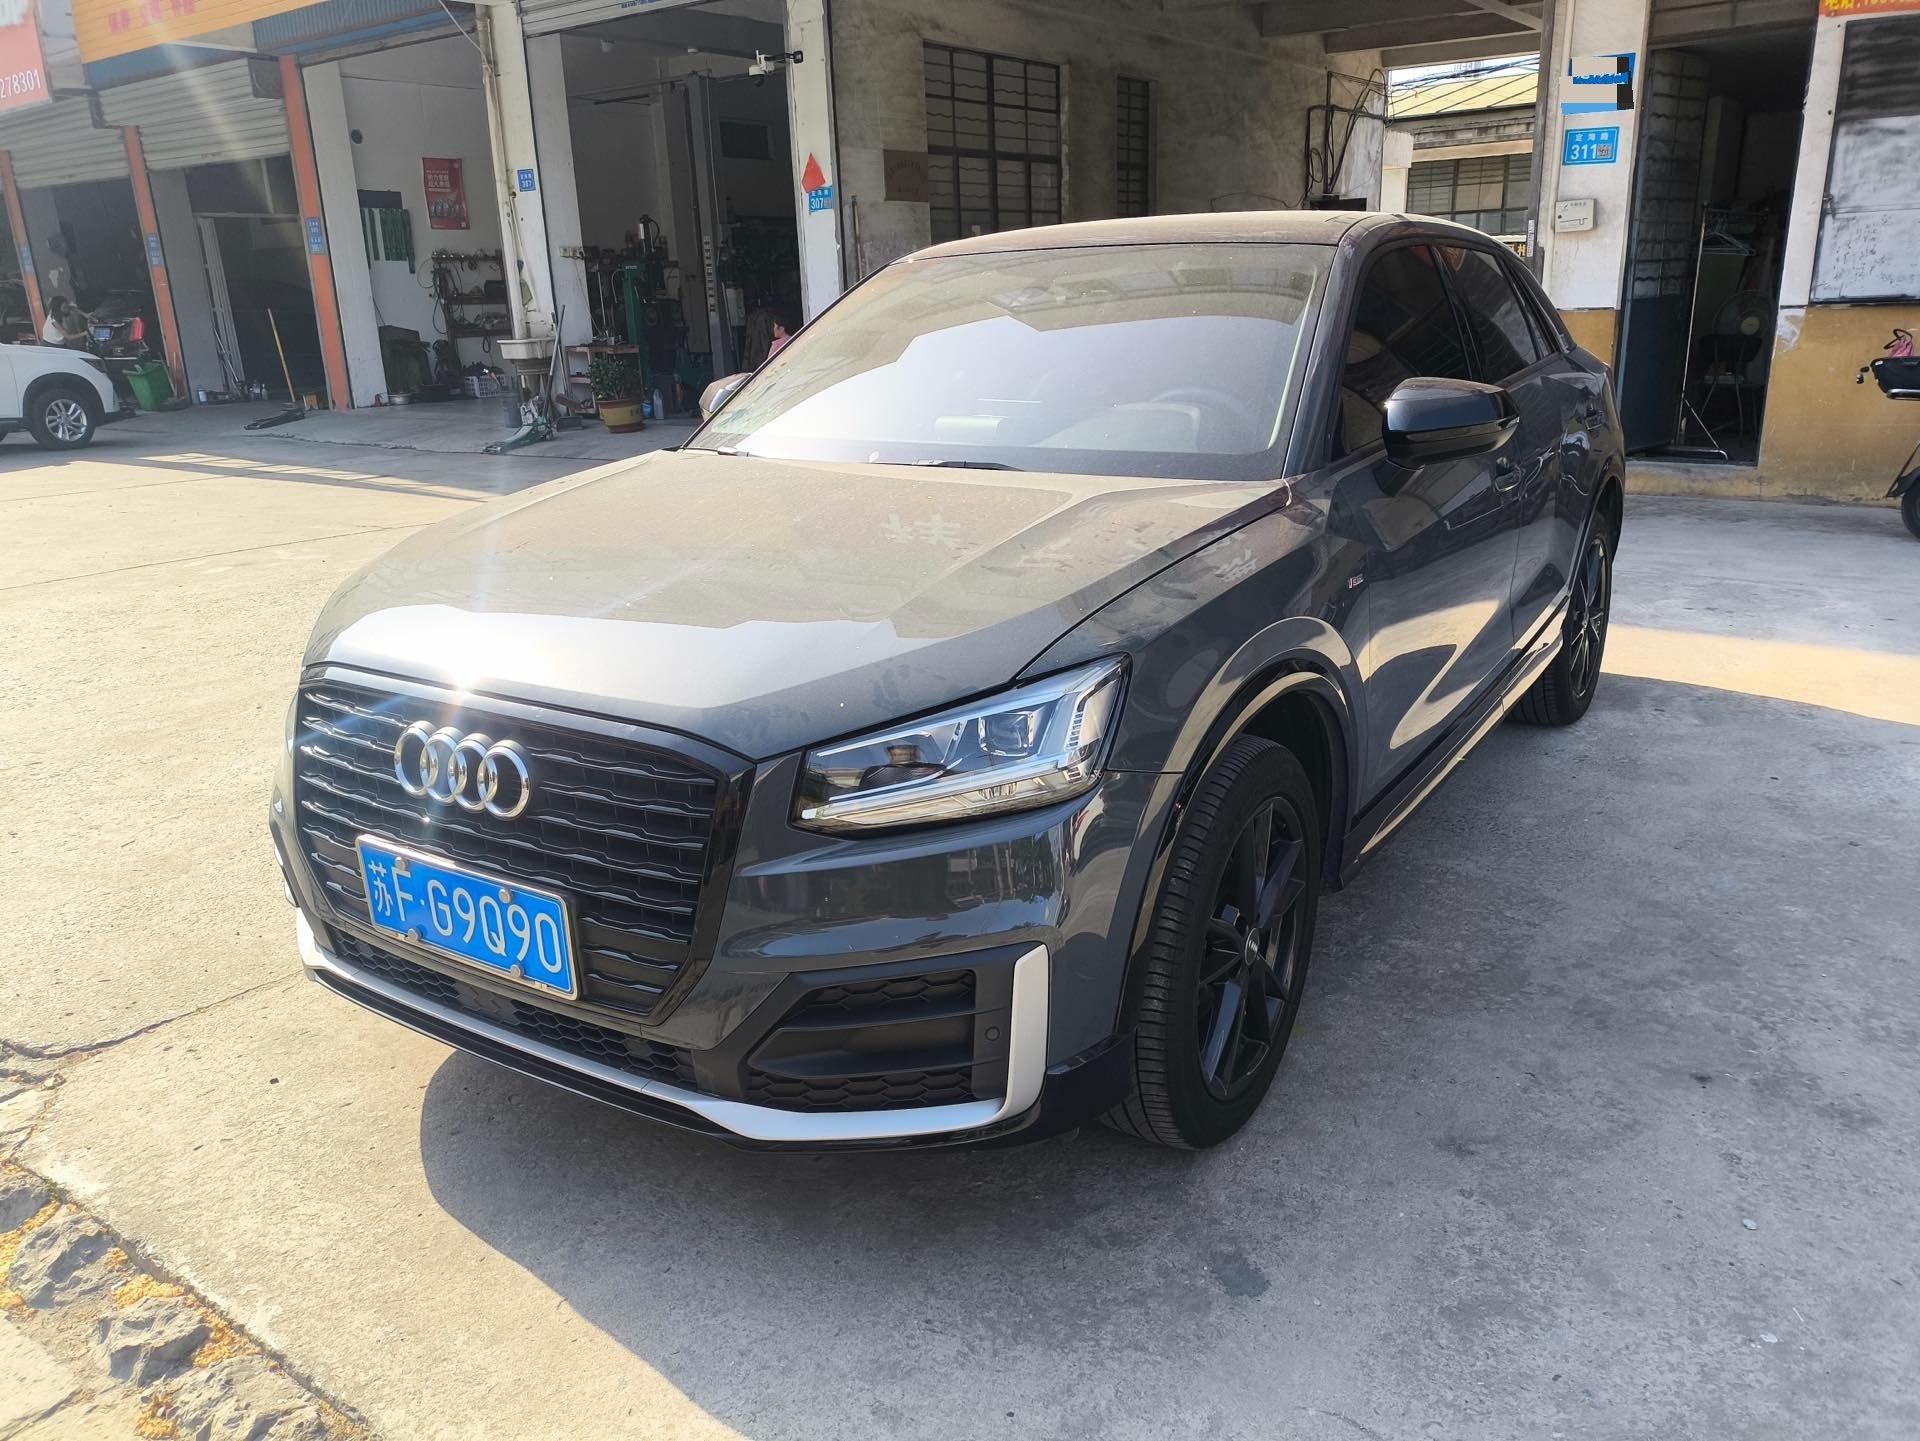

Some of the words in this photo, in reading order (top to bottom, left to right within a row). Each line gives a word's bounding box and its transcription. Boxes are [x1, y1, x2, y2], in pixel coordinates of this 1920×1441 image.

[1575, 133, 1609, 142] 定海路
[1571, 144, 1597, 160] 311
[811, 198, 824, 209] 307
